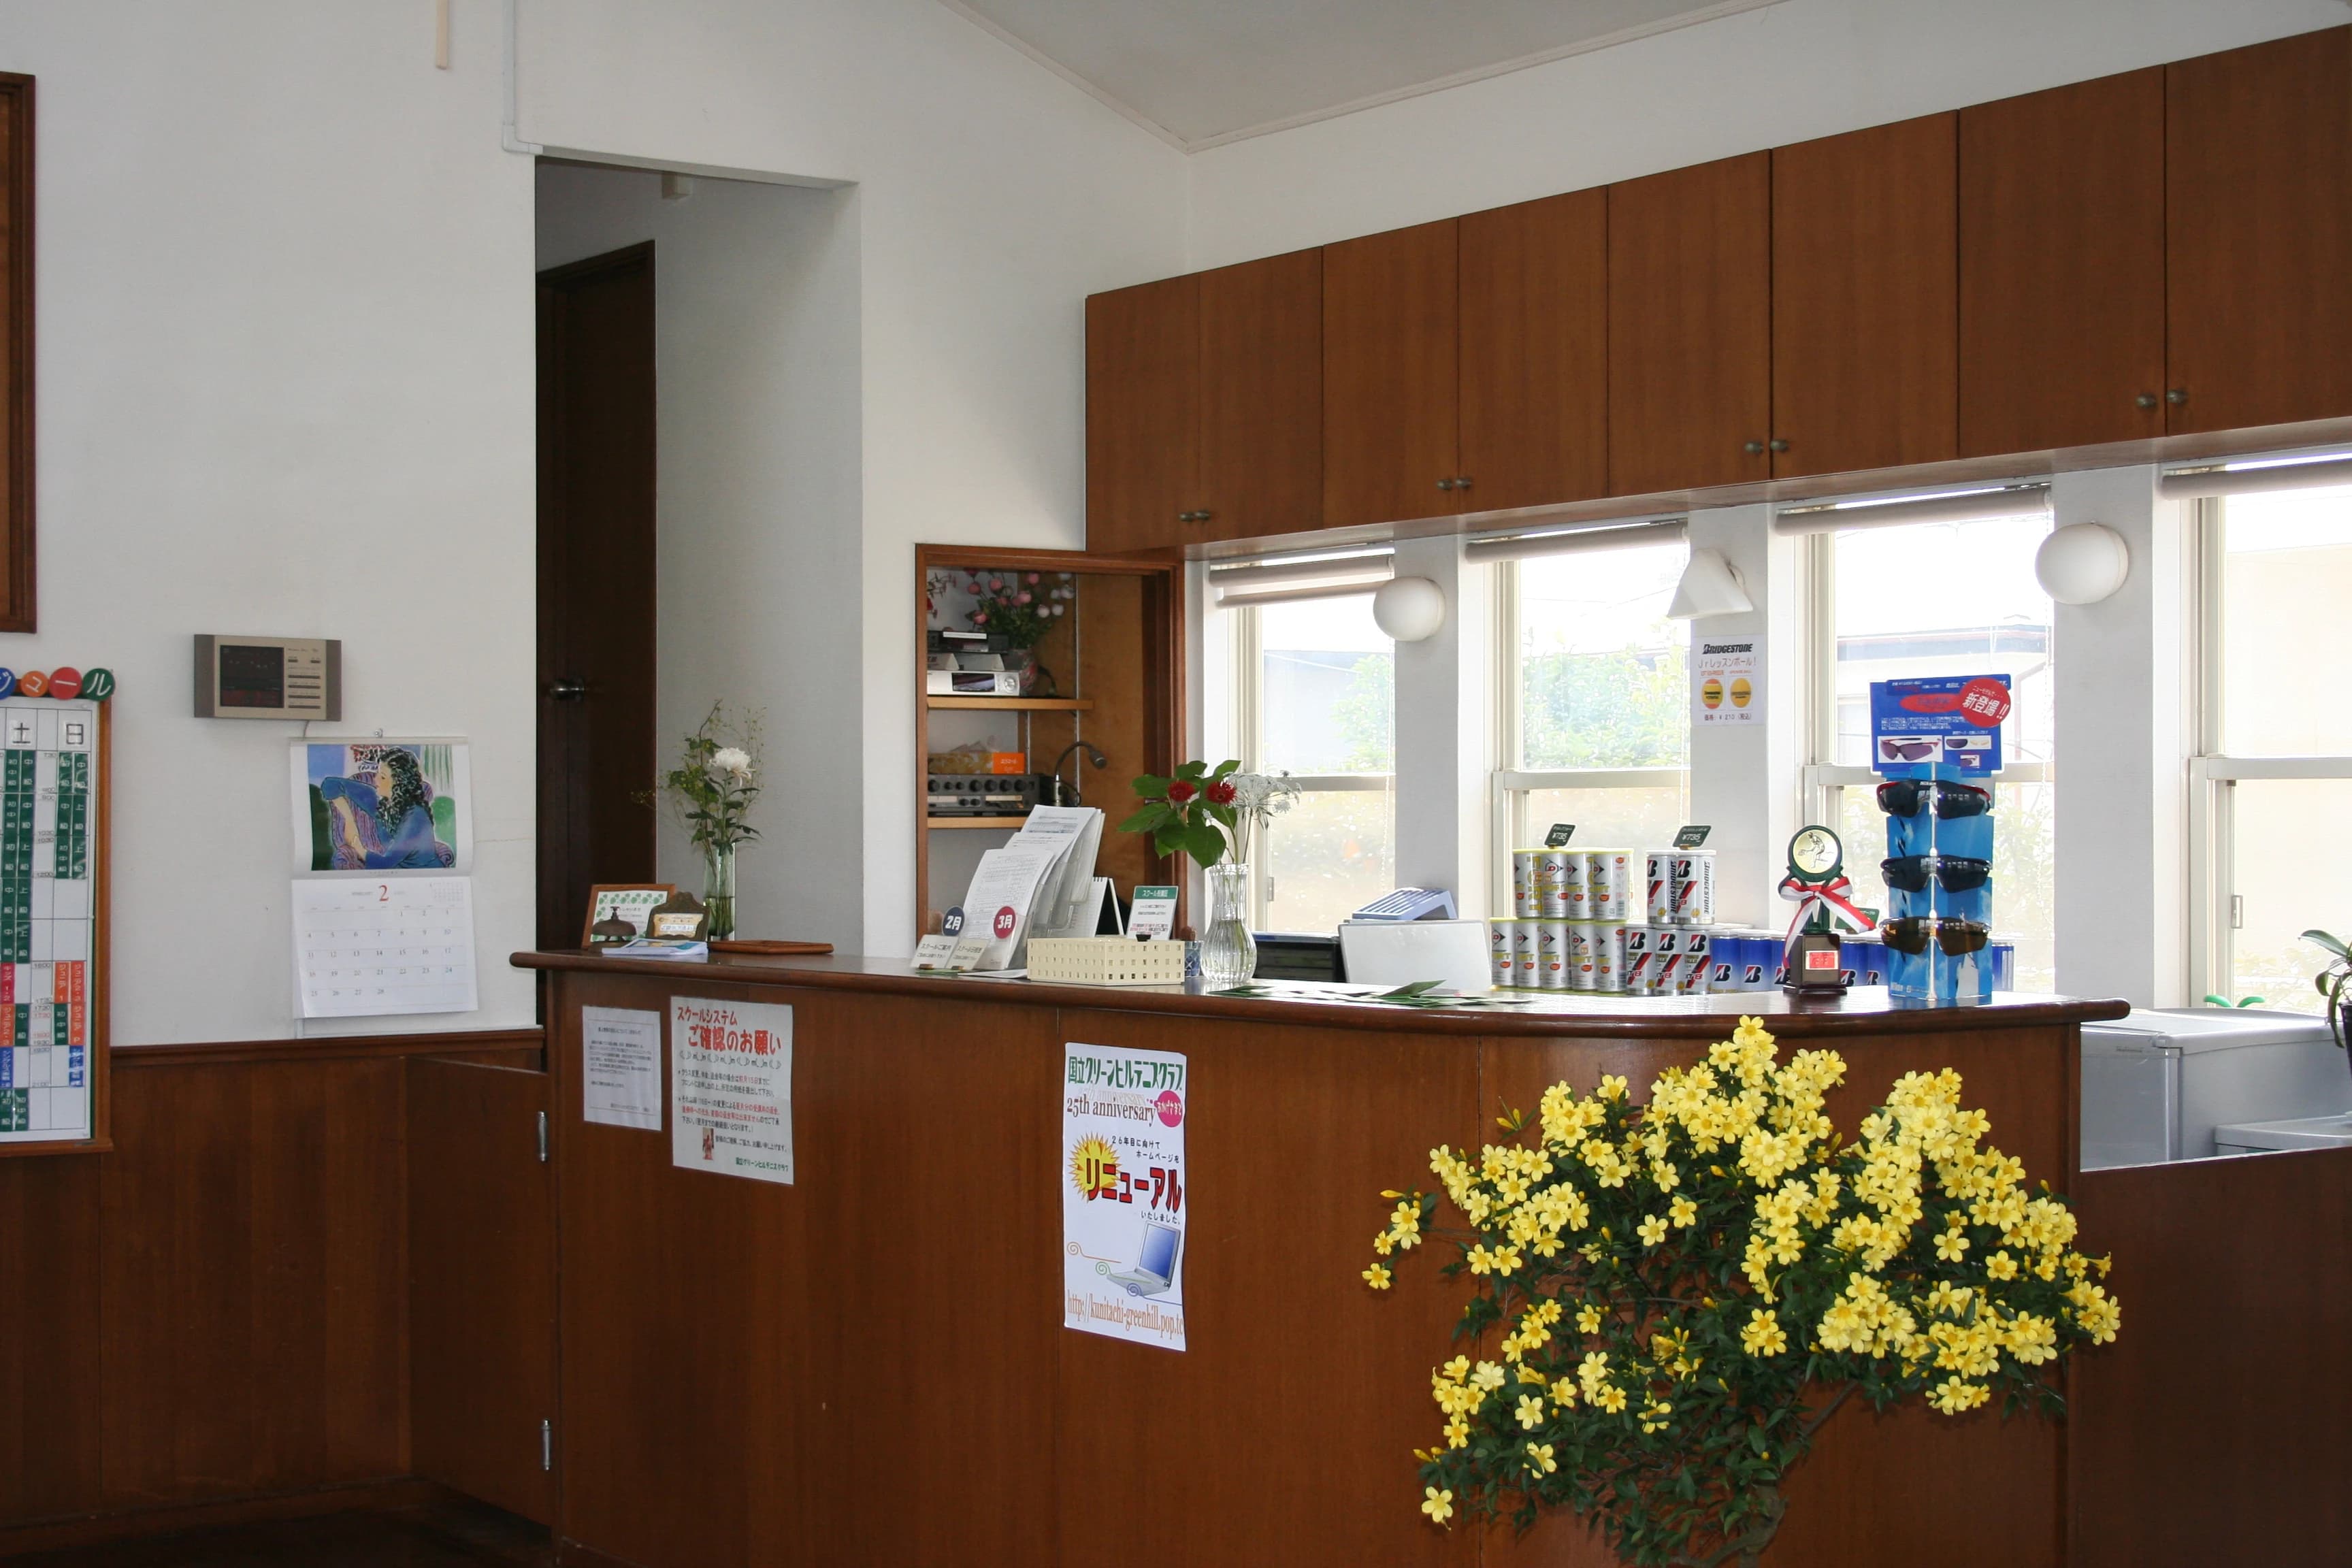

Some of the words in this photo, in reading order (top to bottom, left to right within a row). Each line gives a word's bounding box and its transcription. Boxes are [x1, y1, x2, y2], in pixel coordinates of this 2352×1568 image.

[1703, 644, 1753, 654] BRIDGESTONE
[12, 723, 31, 744] 土
[66, 723, 84, 745] 日
[378, 884, 390, 902] 2
[945, 915, 962, 931] 2月
[997, 914, 1013, 929] 3月
[677, 1006, 738, 1026] スクールシステム
[688, 1025, 781, 1056] ご確認のお願い
[1068, 1056, 1183, 1091] 国立グリーンヒルテニスクラブ
[1067, 1094, 1089, 1118] 25th
[1093, 1097, 1156, 1127] anniversary
[1136, 1149, 1179, 1164] ホームページを
[1086, 1158, 1182, 1213] リニューアル
